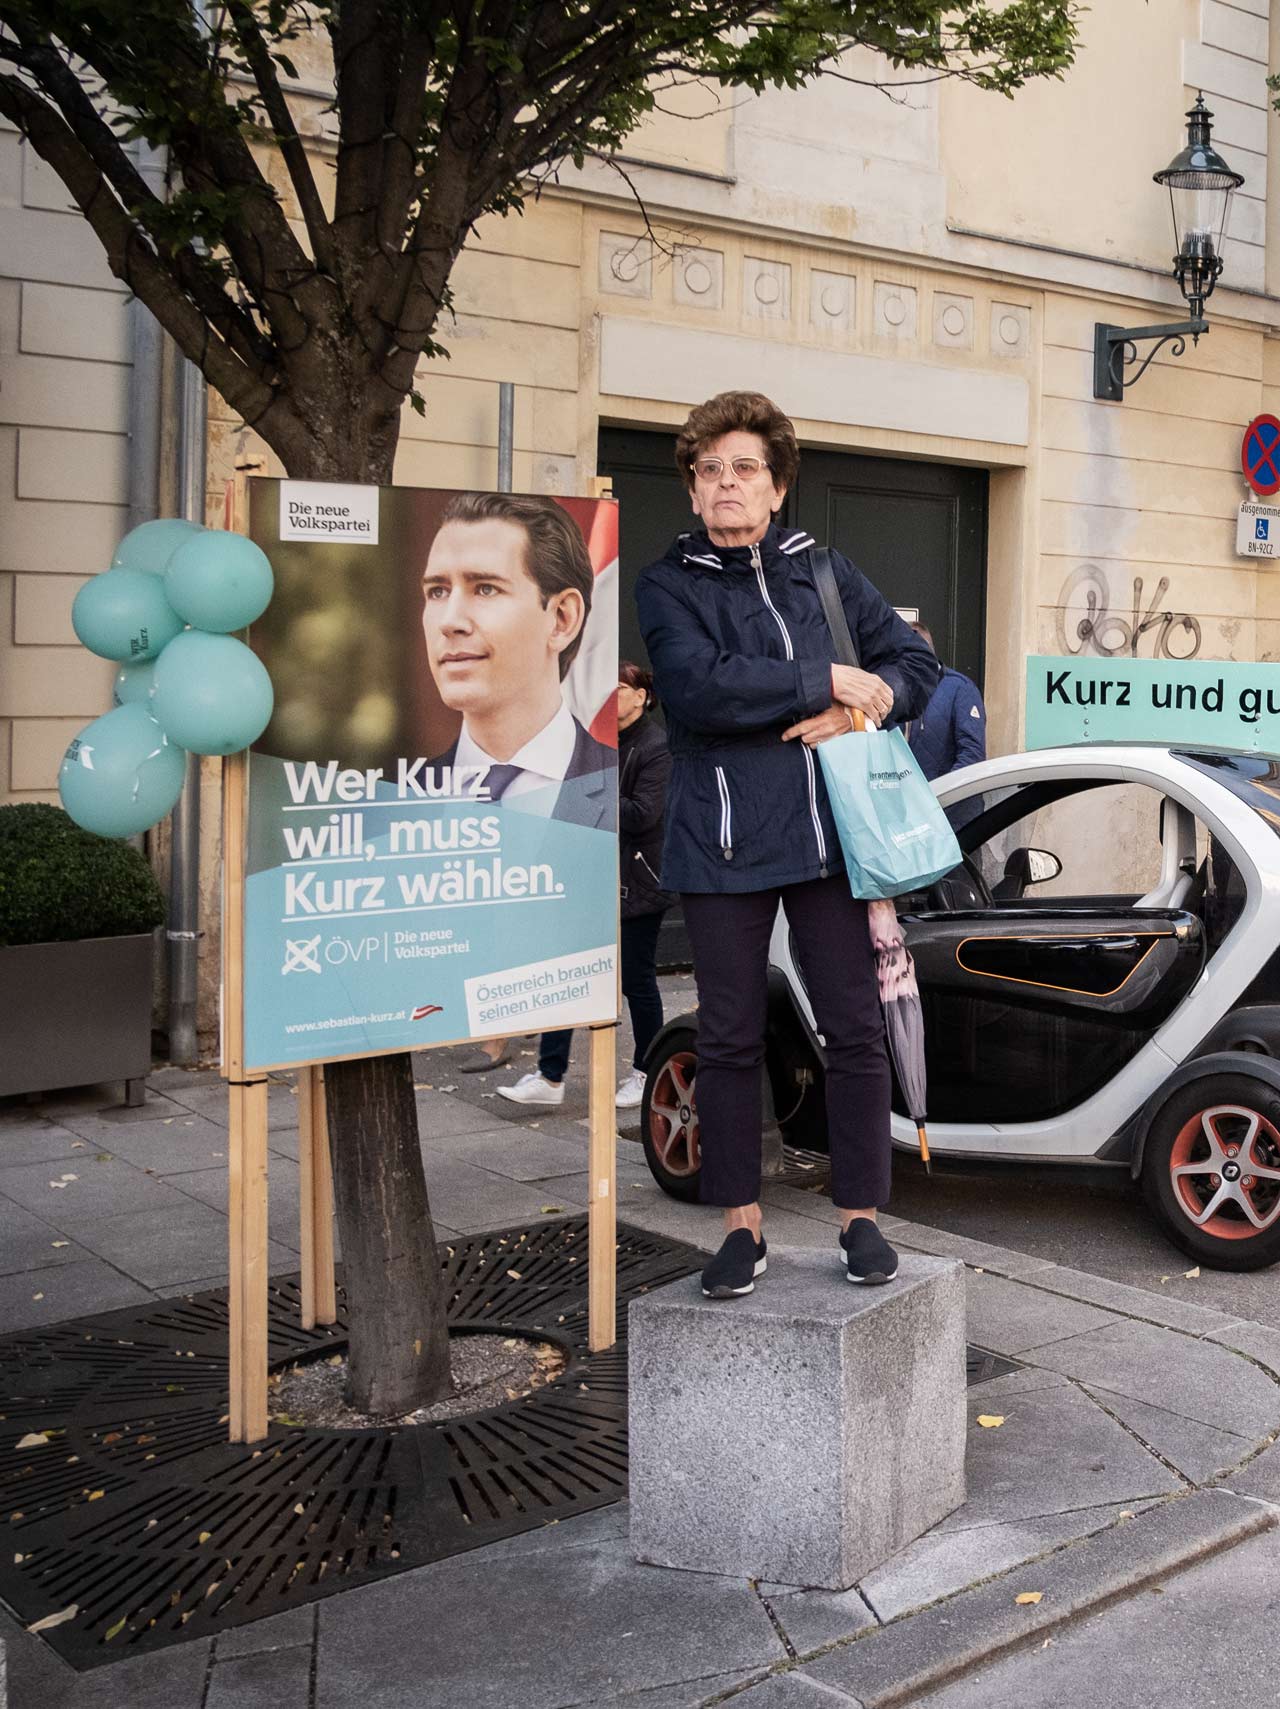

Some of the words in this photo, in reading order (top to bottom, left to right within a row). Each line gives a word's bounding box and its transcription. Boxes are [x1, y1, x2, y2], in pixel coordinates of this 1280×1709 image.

[288, 502, 312, 515] Die
[315, 505, 350, 517] neue
[289, 516, 371, 532] Volkspartei
[1046, 671, 1131, 706] Kurz
[1151, 678, 1224, 712] und
[282, 760, 383, 803] Wer
[397, 757, 492, 799] Kurz
[282, 813, 375, 862] will,
[390, 815, 501, 853] muss
[285, 872, 385, 915] Kurz
[398, 857, 565, 905] wählen.
[325, 935, 380, 965] ÖVP
[394, 931, 417, 944] Die
[420, 929, 453, 941] neue
[394, 939, 470, 960] Volkspartei
[476, 971, 554, 1001] Österreich
[558, 957, 614, 982] braucht
[479, 1000, 528, 1022] seinen
[532, 981, 590, 1008] Kanzler!
[285, 1010, 406, 1034] www.sebastian-kurz.at
